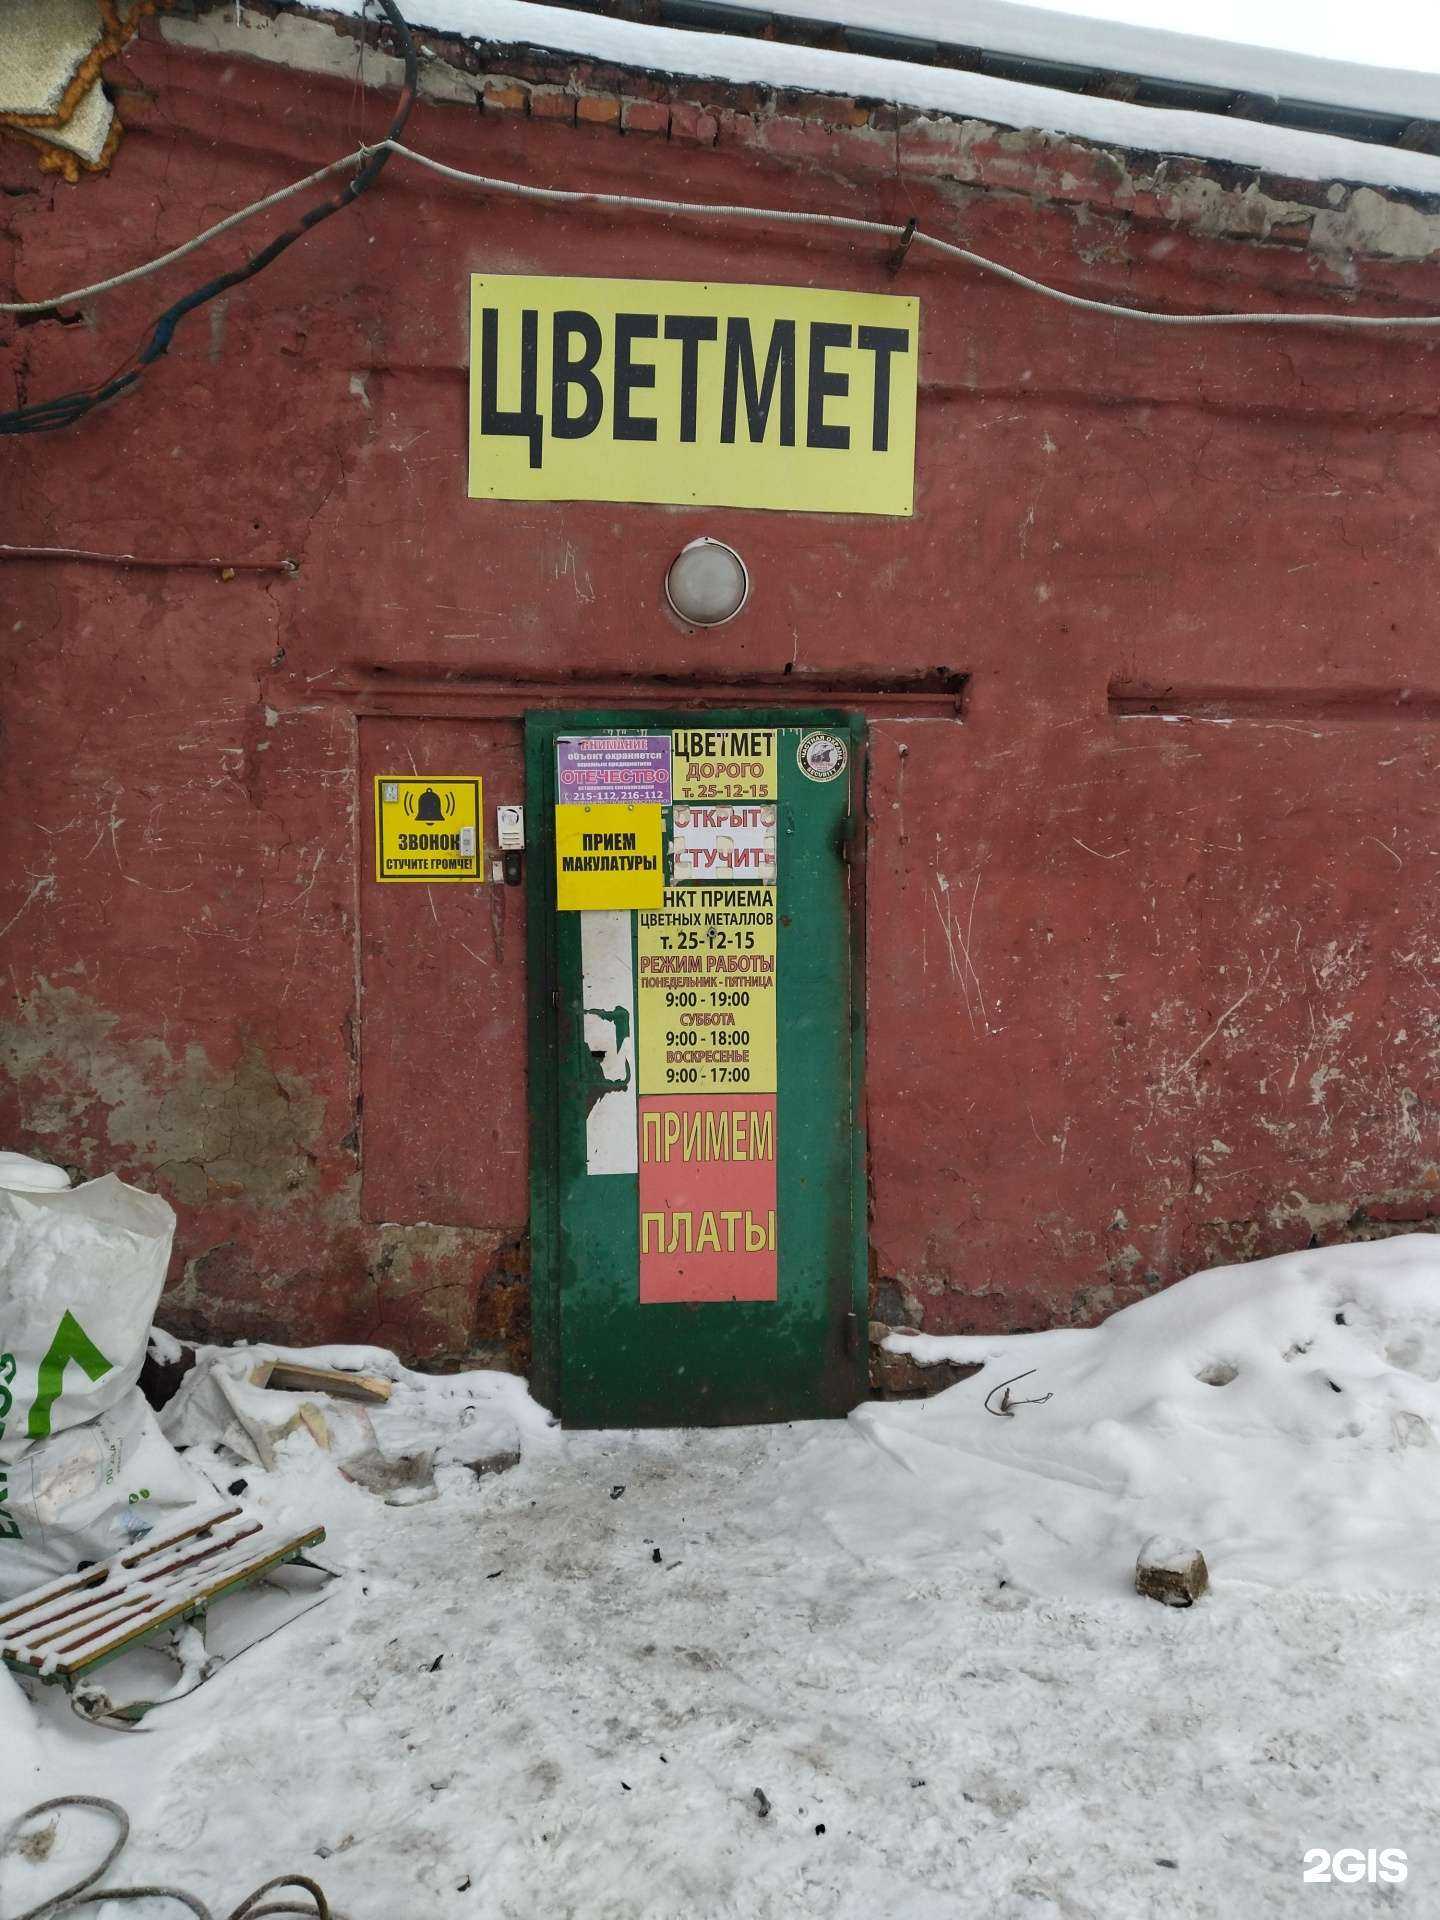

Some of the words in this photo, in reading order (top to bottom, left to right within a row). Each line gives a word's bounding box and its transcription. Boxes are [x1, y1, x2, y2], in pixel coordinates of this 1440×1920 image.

[481, 308, 909, 468] ЦВЕТМЕТ
[674, 732, 774, 761] ЦВЕТМЕТ
[561, 768, 670, 784] ОТЕЧЕСТВО
[686, 762, 765, 781] ДОРОГО
[620, 790, 664, 799] 216-112
[682, 787, 694, 798] т.
[698, 785, 769, 798] 25-12-15
[398, 833, 461, 851] ЗВОНОК
[582, 833, 636, 851] ПРИЕМ
[386, 858, 430, 870] СТУЧИТЕ
[431, 858, 473, 870] ГРОМЧЕ!
[562, 855, 657, 872] МАКУЛАТУРЫ
[662, 890, 697, 907] НКТ
[701, 890, 774, 907] ПРИЕМА
[640, 912, 701, 929] ЦВЕТНЫХ
[704, 912, 774, 926] МЕТАЛЛОВ
[660, 936, 673, 949] т.
[677, 931, 755, 949] 25-12-15
[640, 955, 703, 973] РЕЖИМ
[706, 954, 775, 973] РАБОТЫ
[640, 976, 718, 990] ПОНЕДЕЛЬНИК
[724, 976, 774, 989] ПЯТНИЦА
[665, 992, 698, 1007] 9:00
[710, 991, 750, 1007] 19:00
[679, 1012, 736, 1026] СУББОТА
[665, 1031, 698, 1046] 9:00
[710, 1031, 750, 1046] 18:00
[666, 1050, 750, 1063] ВОСКРЕСЕНЬЕ
[666, 1068, 698, 1083] 9:00
[710, 1068, 750, 1083] 17:00
[642, 1111, 774, 1163] ПРИМЕМ
[641, 1210, 777, 1254] ПЛАТЫ
